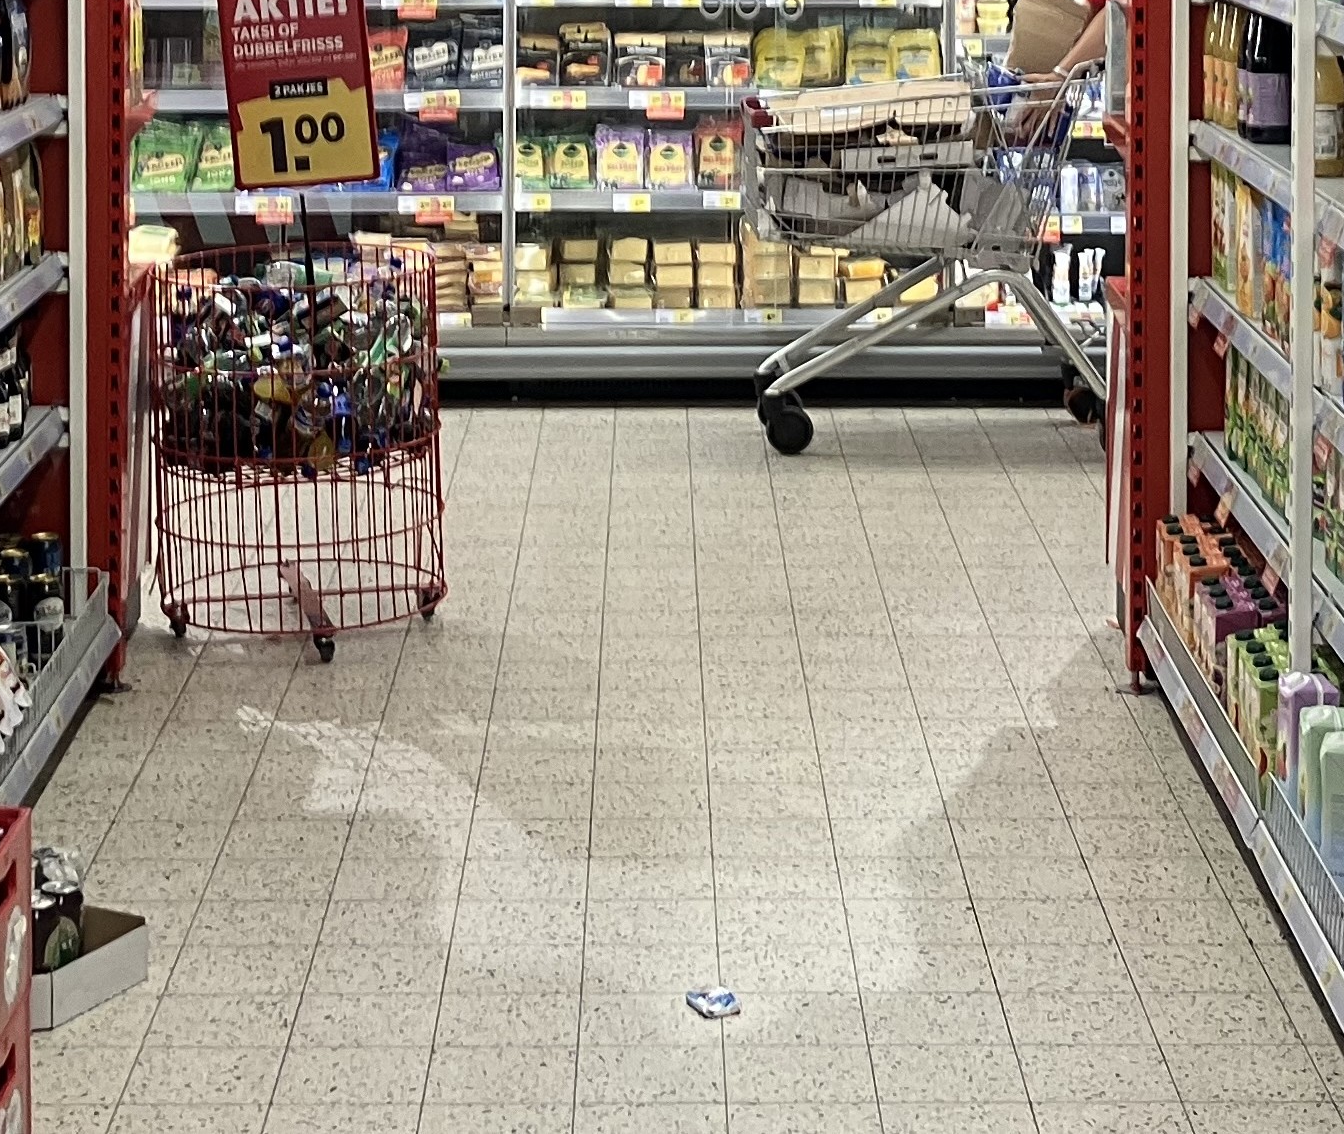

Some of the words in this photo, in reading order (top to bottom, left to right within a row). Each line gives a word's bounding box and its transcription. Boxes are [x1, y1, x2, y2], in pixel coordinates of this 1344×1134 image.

[231, 24, 275, 43] TAKSI
[278, 22, 299, 39] OF
[259, 110, 346, 174] 1.00
